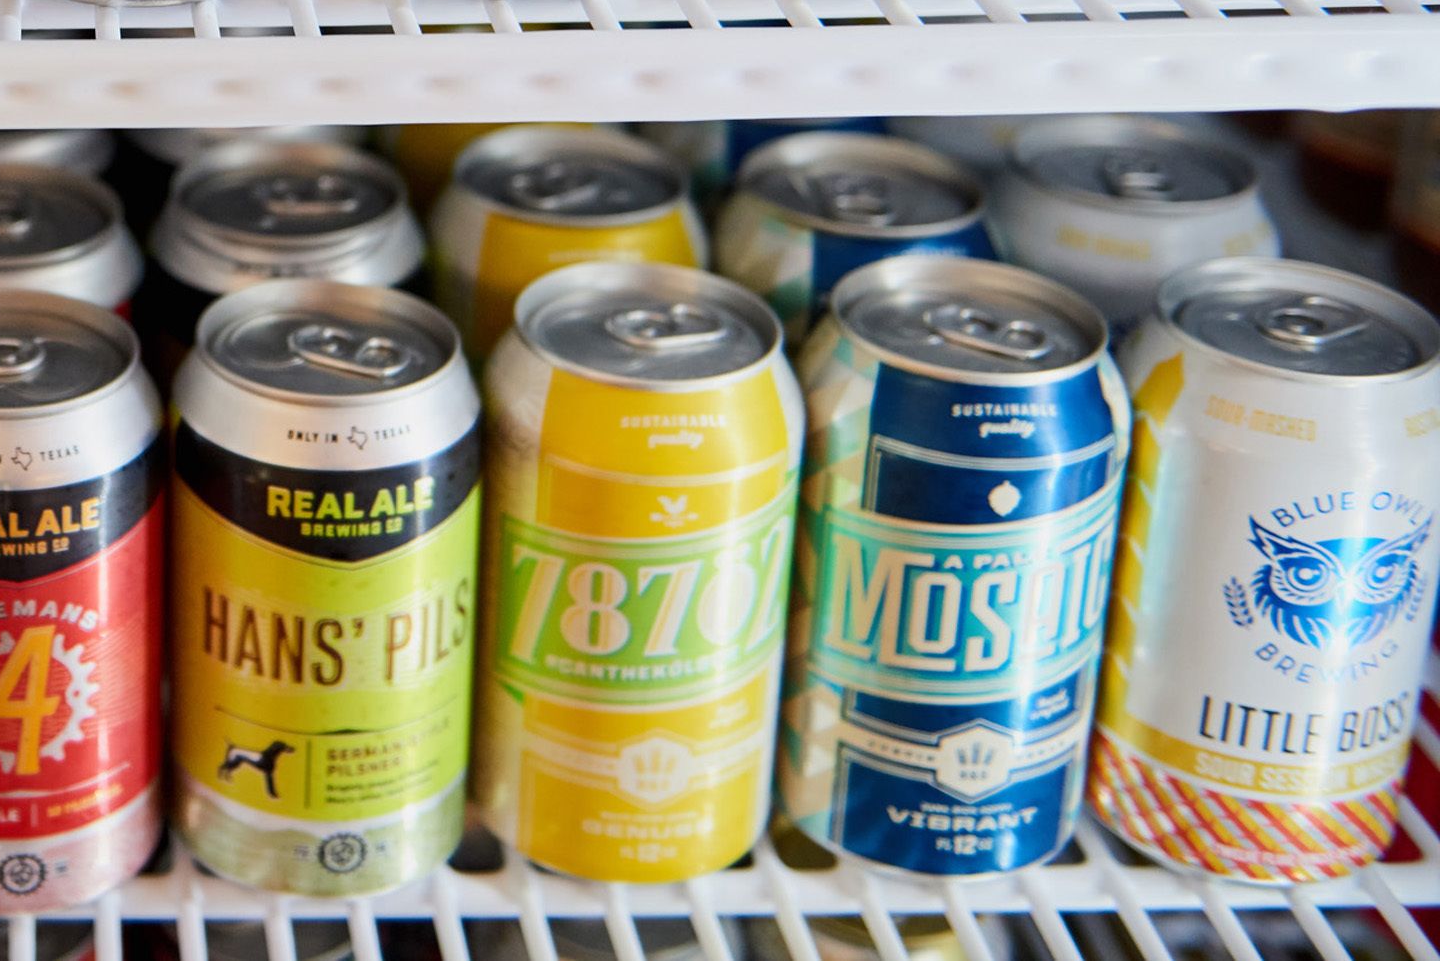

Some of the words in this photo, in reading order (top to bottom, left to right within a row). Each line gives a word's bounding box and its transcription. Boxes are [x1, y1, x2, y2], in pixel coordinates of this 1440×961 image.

[951, 402, 1057, 418] SUSTAINABLE
[39, 444, 80, 461] TEXAS
[266, 485, 364, 520] REAL
[370, 475, 435, 518] ALE
[1270, 491, 1356, 528] BLUE
[1370, 491, 1426, 526] OWL
[34, 496, 103, 537] ALE
[300, 520, 382, 537] BREWING
[202, 585, 365, 687] HANS'
[384, 578, 470, 684] PILS
[1199, 695, 1324, 755] LITTLE
[885, 804, 1038, 831] VIBRANT
